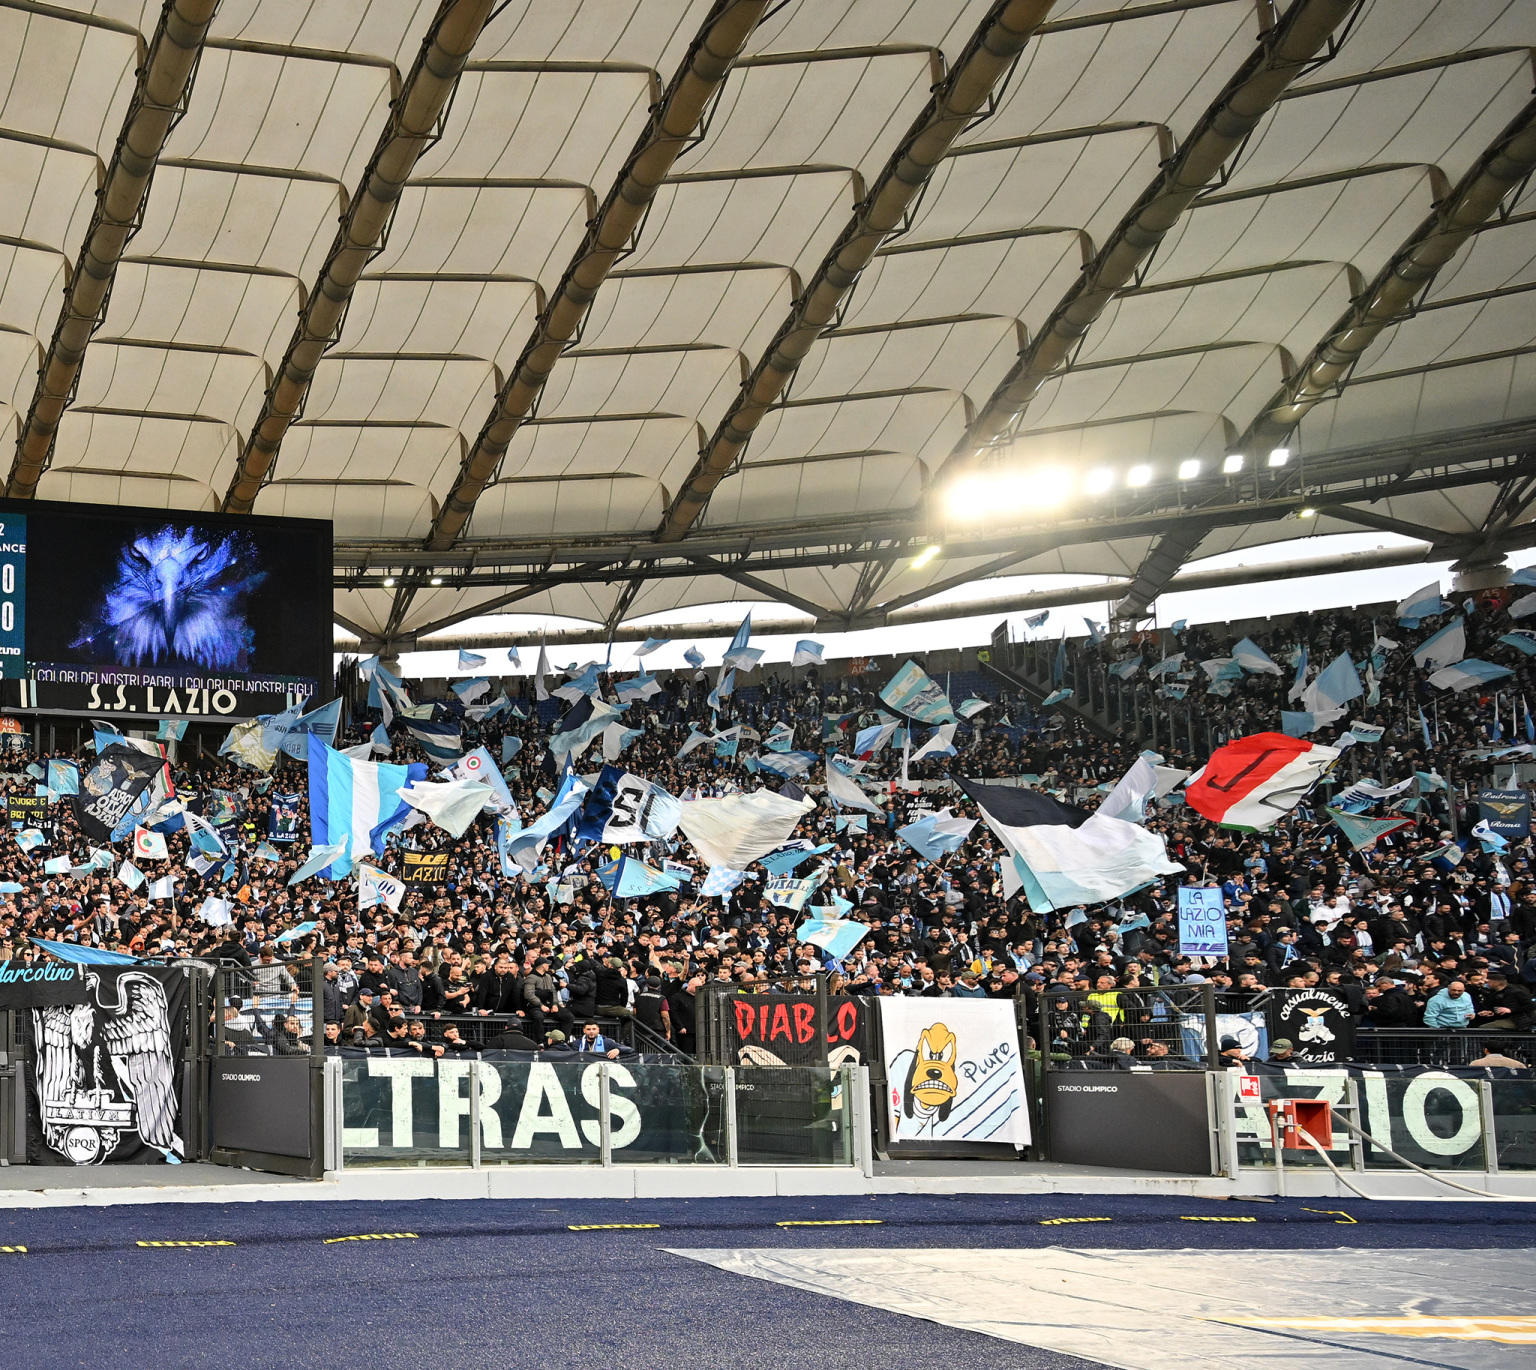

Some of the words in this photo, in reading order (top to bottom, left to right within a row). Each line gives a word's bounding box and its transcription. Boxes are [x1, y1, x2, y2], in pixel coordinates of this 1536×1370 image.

[2, 563, 14, 594] 0
[2, 601, 14, 632] 0
[88, 684, 136, 711] S.S.
[147, 687, 236, 714] LAZIO
[2, 718, 15, 728] 48
[403, 866, 446, 882] LAZIO
[1189, 891, 1204, 904] LA
[1180, 907, 1222, 922] LAZIO
[1188, 924, 1216, 938] MIA
[1280, 988, 1350, 1021] casualmente
[1300, 1047, 1335, 1062] lazio
[238, 1074, 261, 1082] OLIMPICO
[68, 1138, 96, 1152] SPQR
